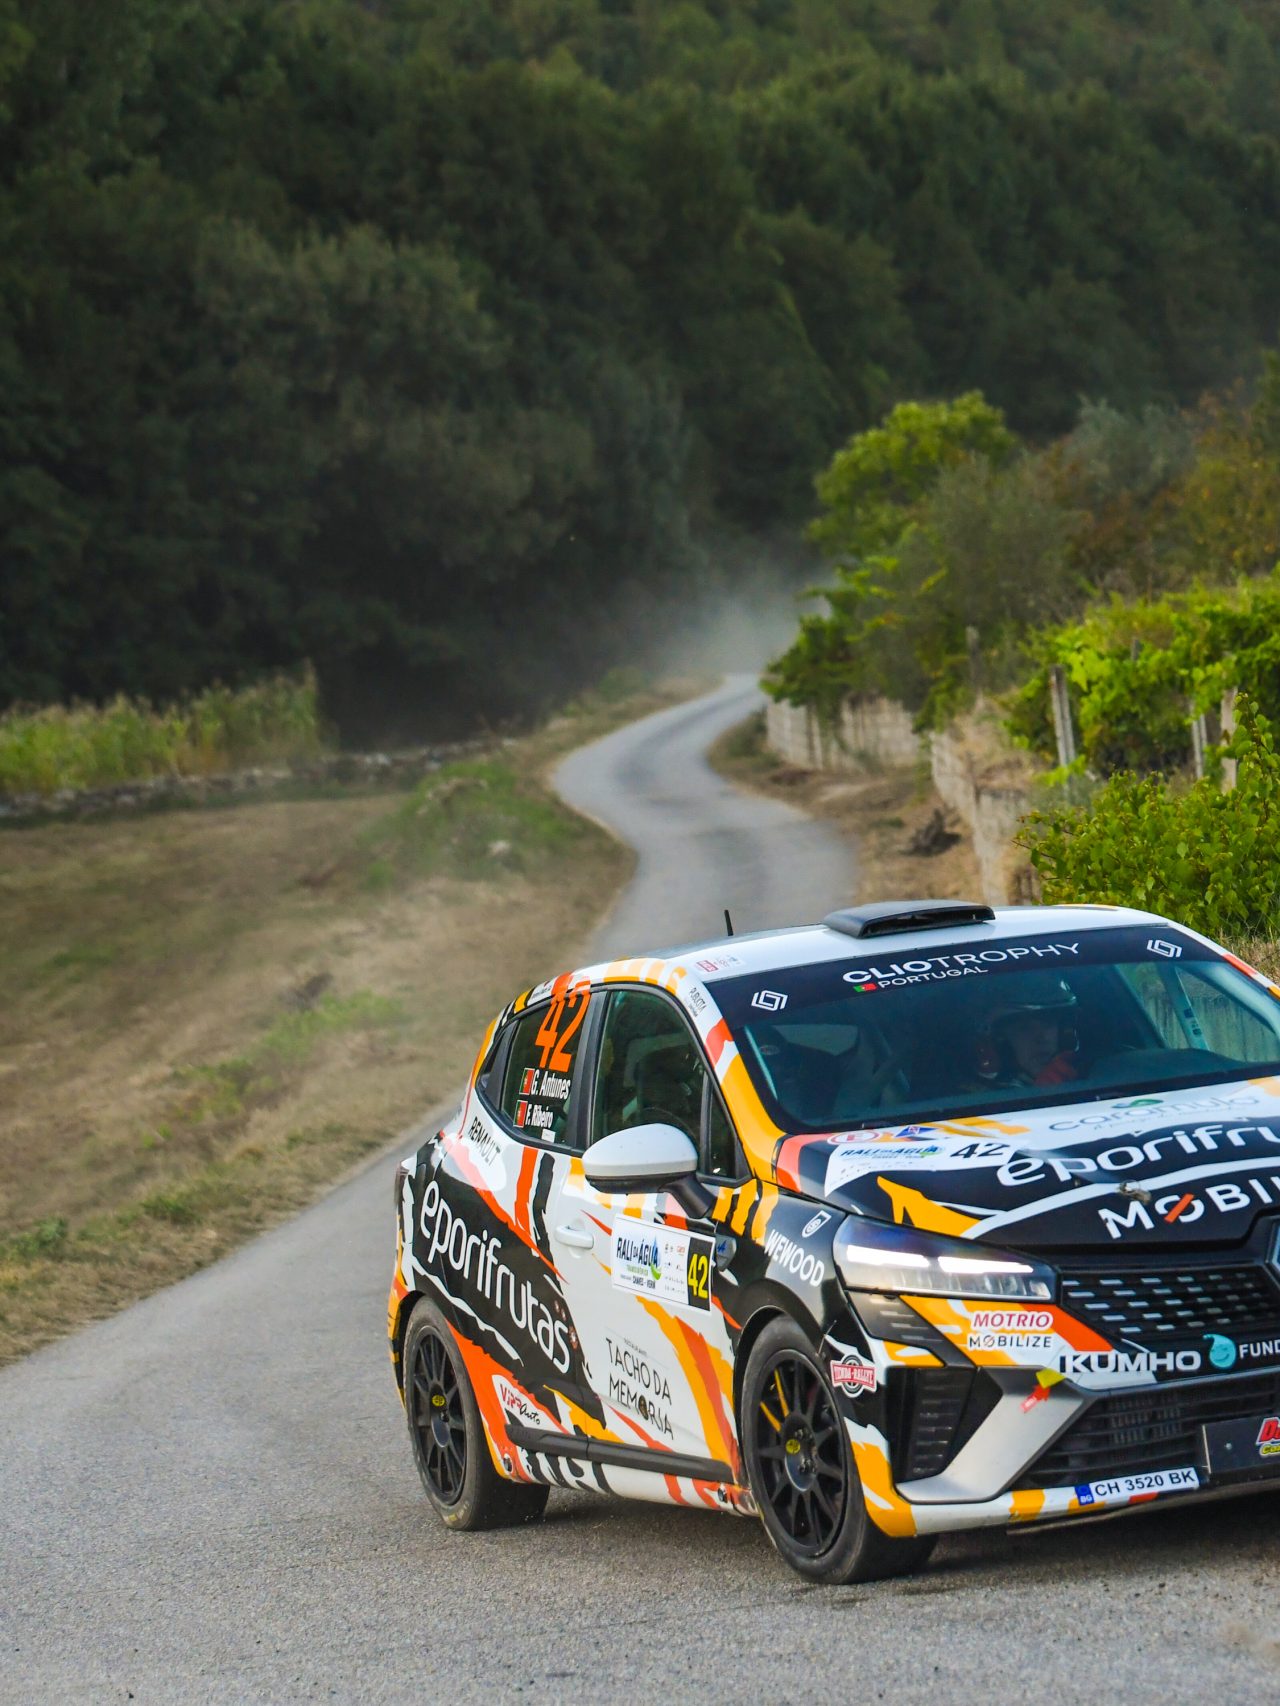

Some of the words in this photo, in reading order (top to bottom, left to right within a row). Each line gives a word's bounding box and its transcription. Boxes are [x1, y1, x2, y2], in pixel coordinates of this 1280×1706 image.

[878, 966, 989, 989] PORTUGAL
[535, 986, 591, 1073] 42
[531, 1069, 540, 1095] G.
[539, 1071, 571, 1100] Antunes
[531, 1105, 554, 1129] Ribeiro
[468, 1115, 501, 1167] RENAULT
[950, 1142, 1011, 1161] 42
[616, 1237, 634, 1262] RALI
[638, 1239, 659, 1268] ÁGUA
[763, 1229, 825, 1288] WEWOOD
[420, 1180, 571, 1374] eporifrutas
[688, 1253, 708, 1299] 42
[972, 1312, 1050, 1329] MOTRIO
[606, 1337, 651, 1389] TACHO
[653, 1369, 673, 1406] DA
[1059, 1350, 1202, 1373] KUMHO
[1095, 1481, 1120, 1496] CH
[1125, 1474, 1164, 1491] 3520
[1169, 1470, 1195, 1485] BK
[1080, 1494, 1093, 1504] BG
